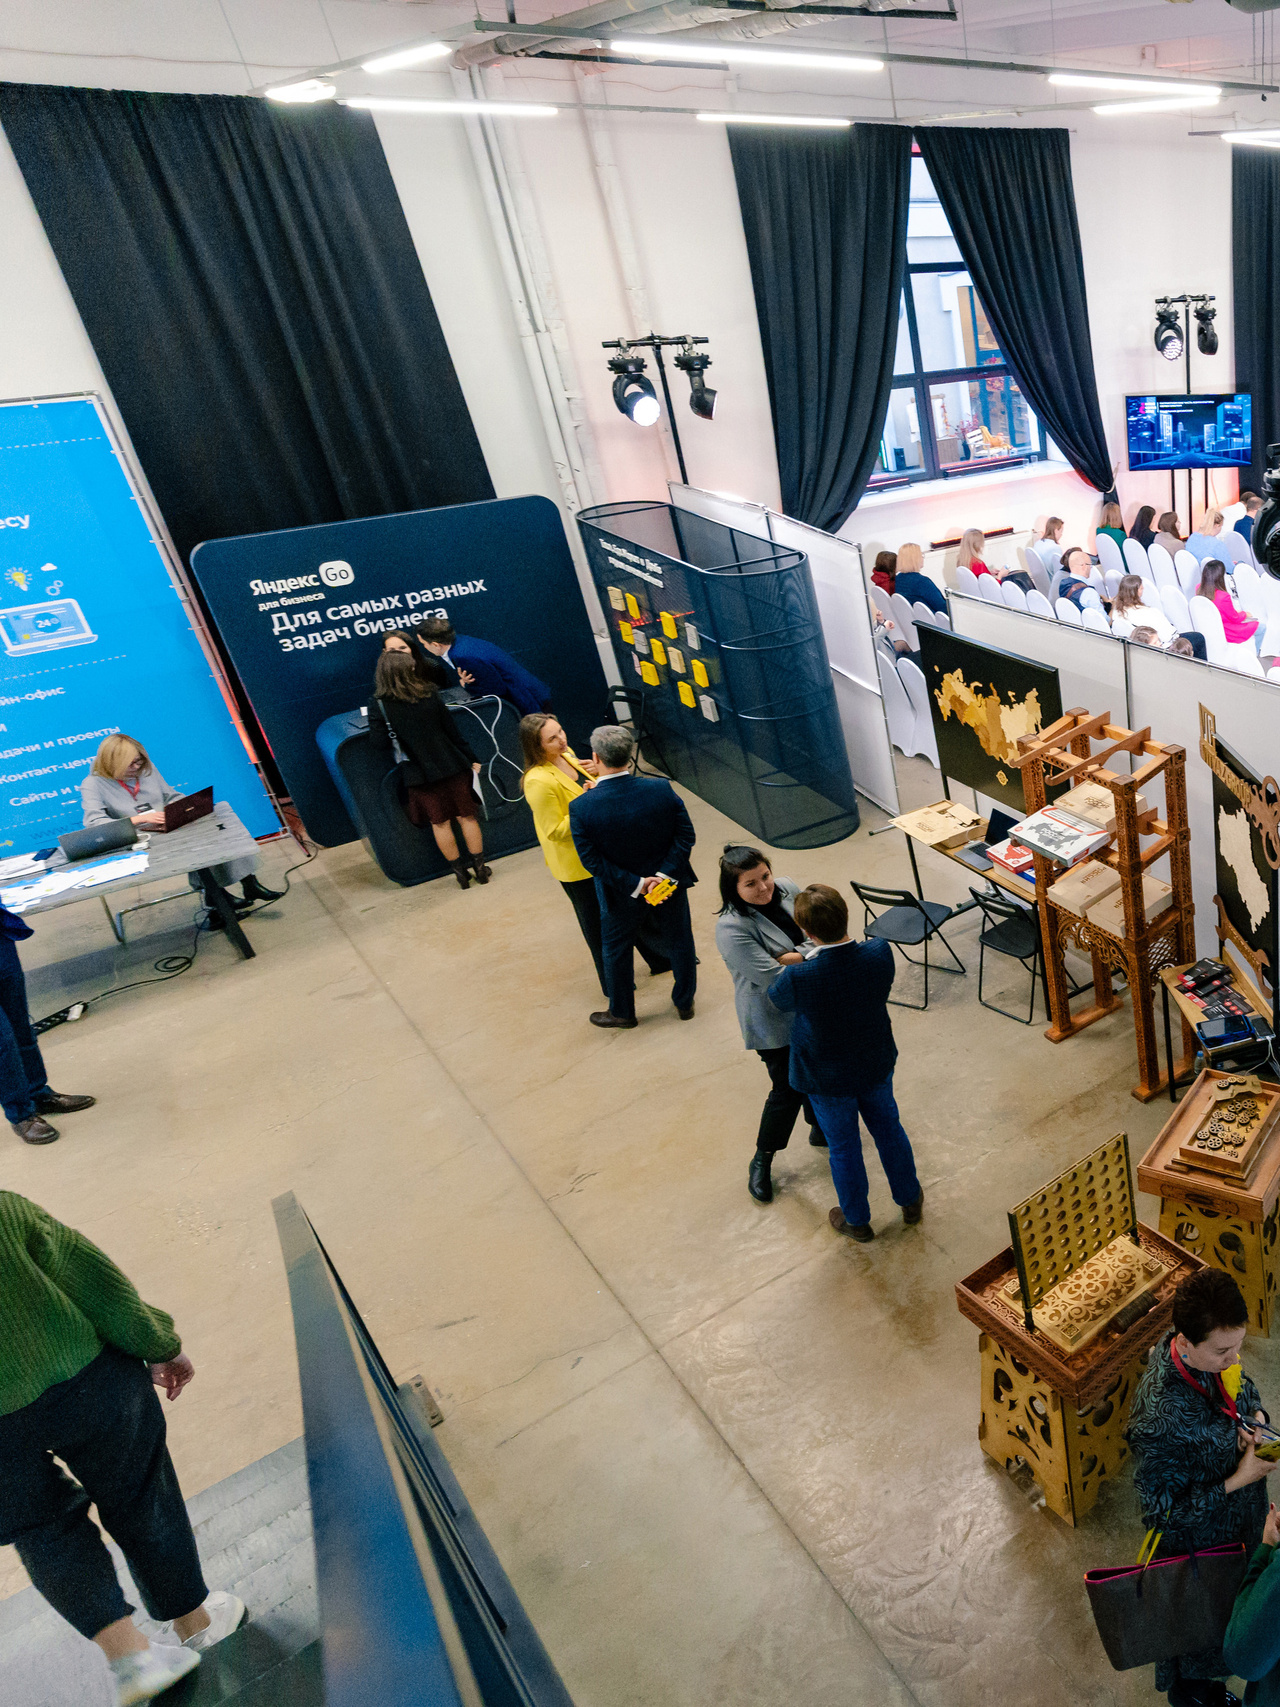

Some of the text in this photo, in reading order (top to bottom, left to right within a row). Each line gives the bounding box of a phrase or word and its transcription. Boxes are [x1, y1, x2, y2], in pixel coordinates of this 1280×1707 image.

[249, 567, 350, 596] Яндекс Go
[258, 592, 326, 612] для бизнеса
[271, 579, 488, 636] Для самых разных
[278, 607, 449, 652] задач бизнеса
[43, 740, 55, 749] и
[57, 726, 121, 746] проекты
[0, 756, 97, 784] Контакт-цент
[9, 790, 58, 807] Сайты
[60, 786, 72, 795] и
